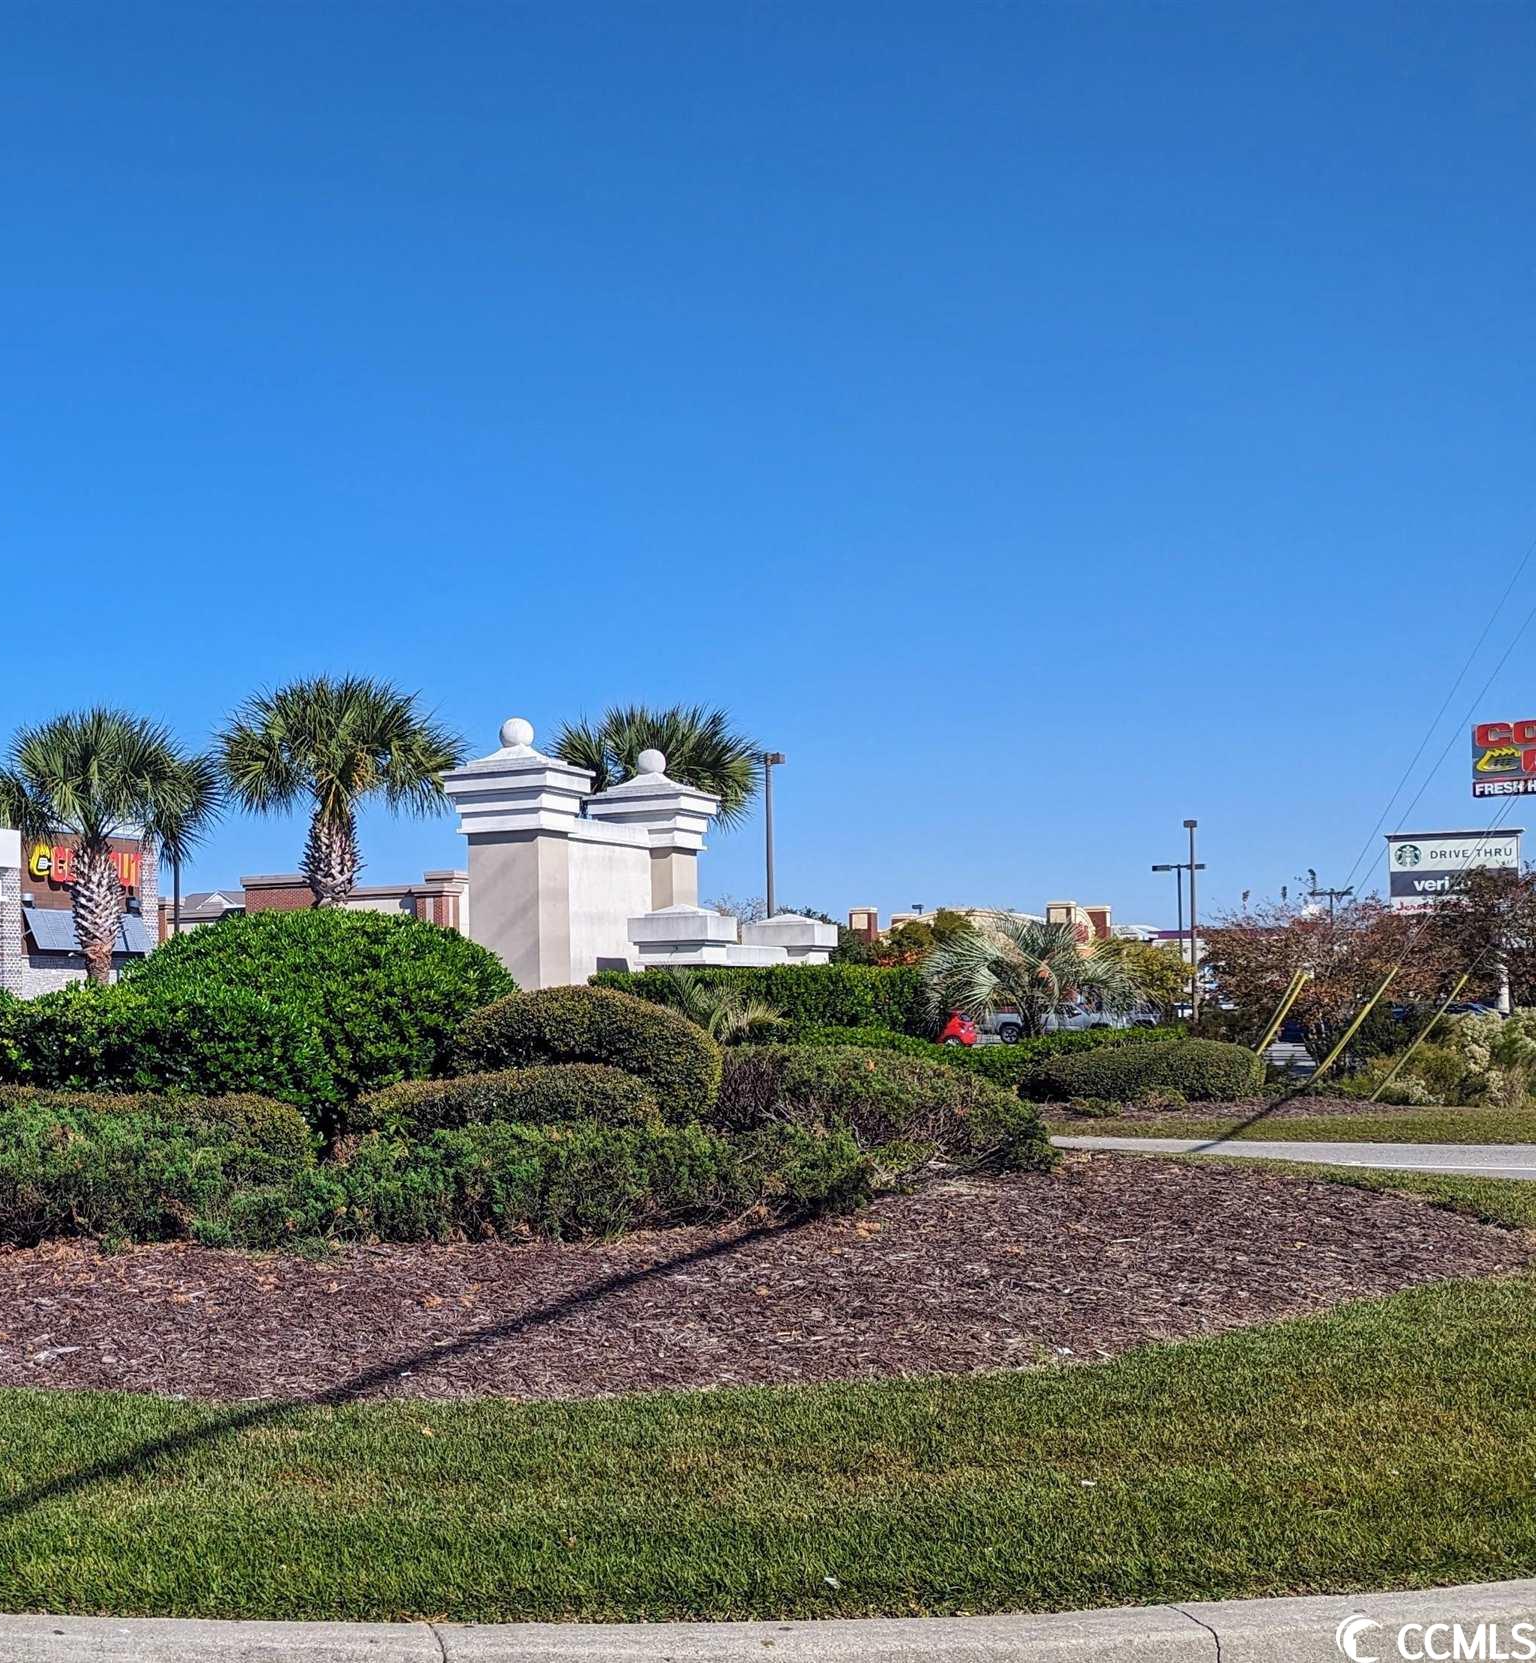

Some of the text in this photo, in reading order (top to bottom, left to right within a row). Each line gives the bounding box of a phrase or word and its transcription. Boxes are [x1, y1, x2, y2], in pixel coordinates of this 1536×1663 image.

[1475, 780, 1524, 796] FRESH
[1430, 847, 1513, 860] DRIVE THRU
